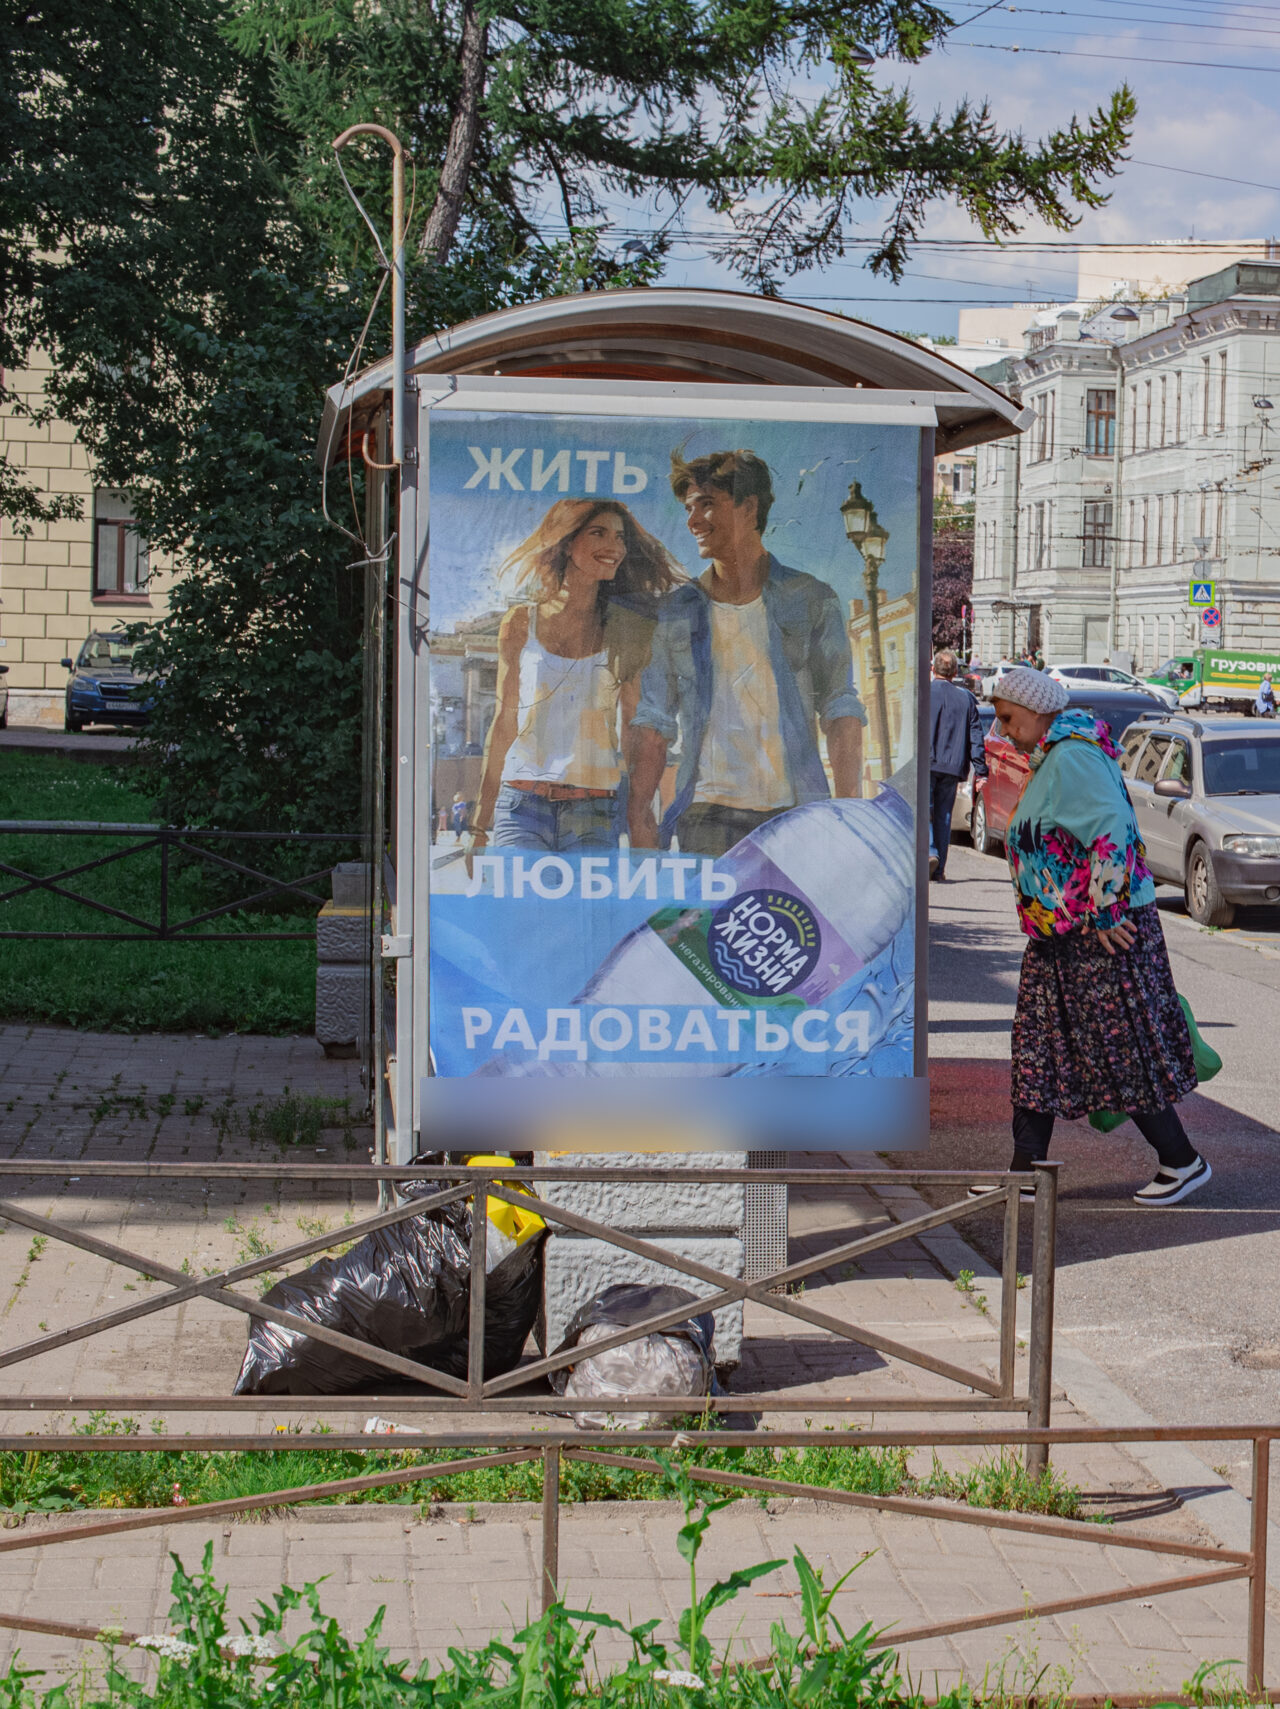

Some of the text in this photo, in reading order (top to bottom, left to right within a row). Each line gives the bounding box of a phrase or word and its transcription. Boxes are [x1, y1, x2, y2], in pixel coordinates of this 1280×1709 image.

[463, 446, 649, 494] ЖИТЬ
[465, 856, 738, 902] ЛЮБИТЬ
[714, 912, 793, 993] ЖИЗНИ
[733, 896, 809, 976] НОРМА
[461, 1006, 870, 1061] РАДОВАТЬСЯ
